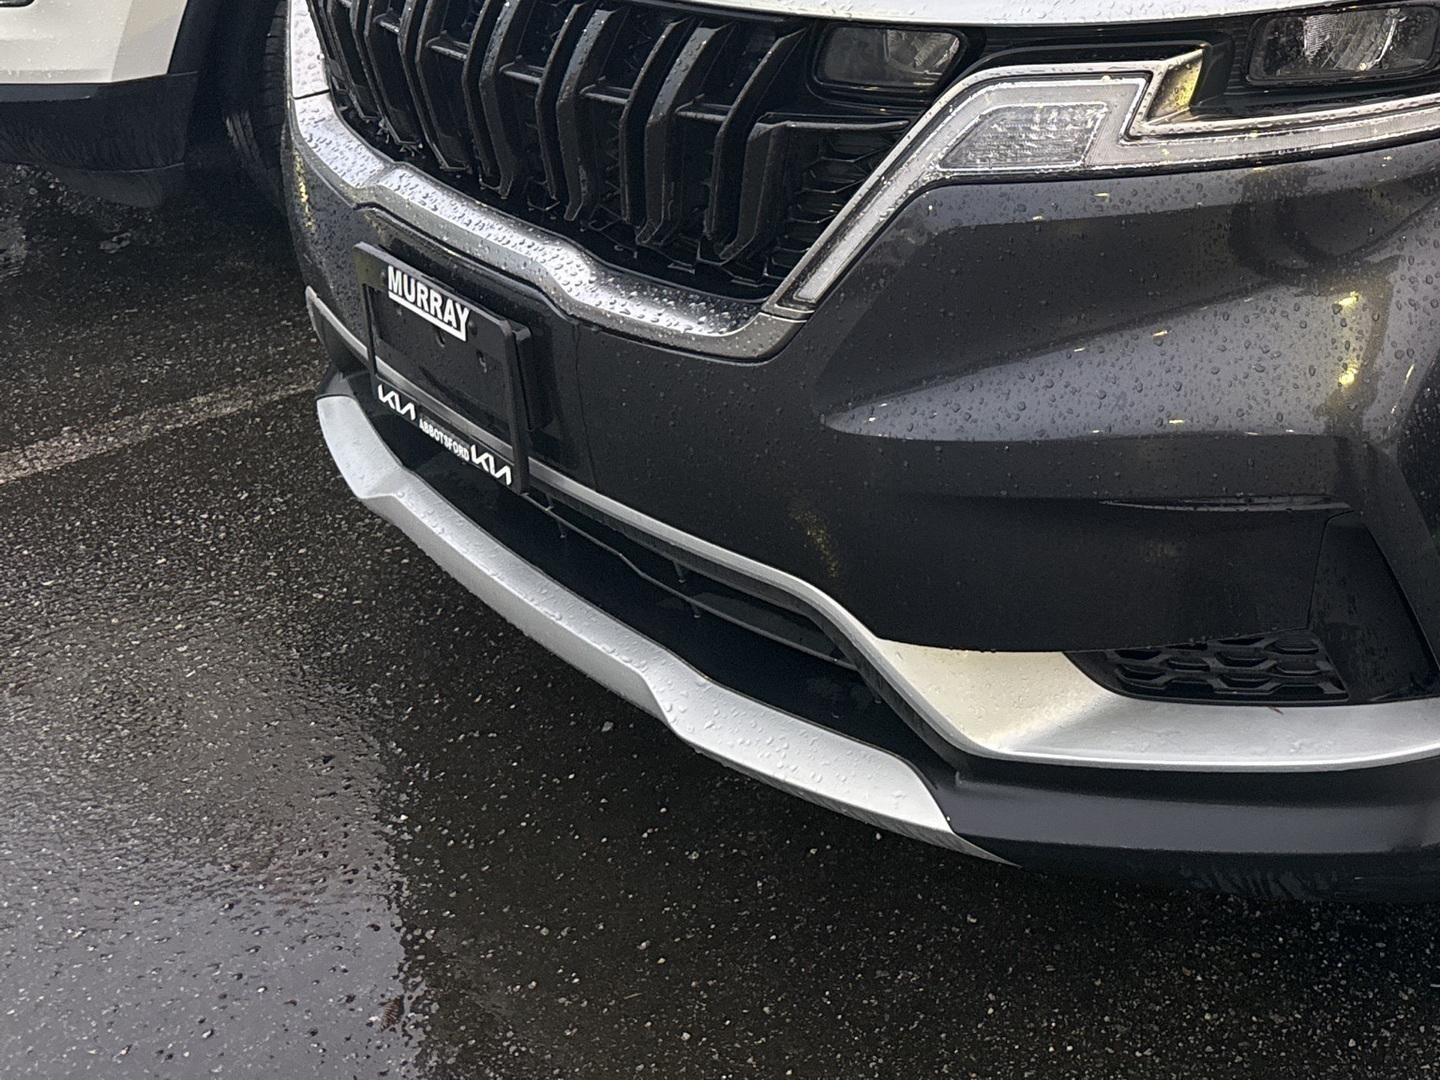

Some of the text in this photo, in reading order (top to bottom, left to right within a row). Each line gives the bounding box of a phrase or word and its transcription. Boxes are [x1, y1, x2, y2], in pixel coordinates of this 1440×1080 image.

[387, 265, 469, 329] MURRAY
[377, 384, 416, 421] KIA
[419, 416, 512, 486] ABBOTSFORD KIA
